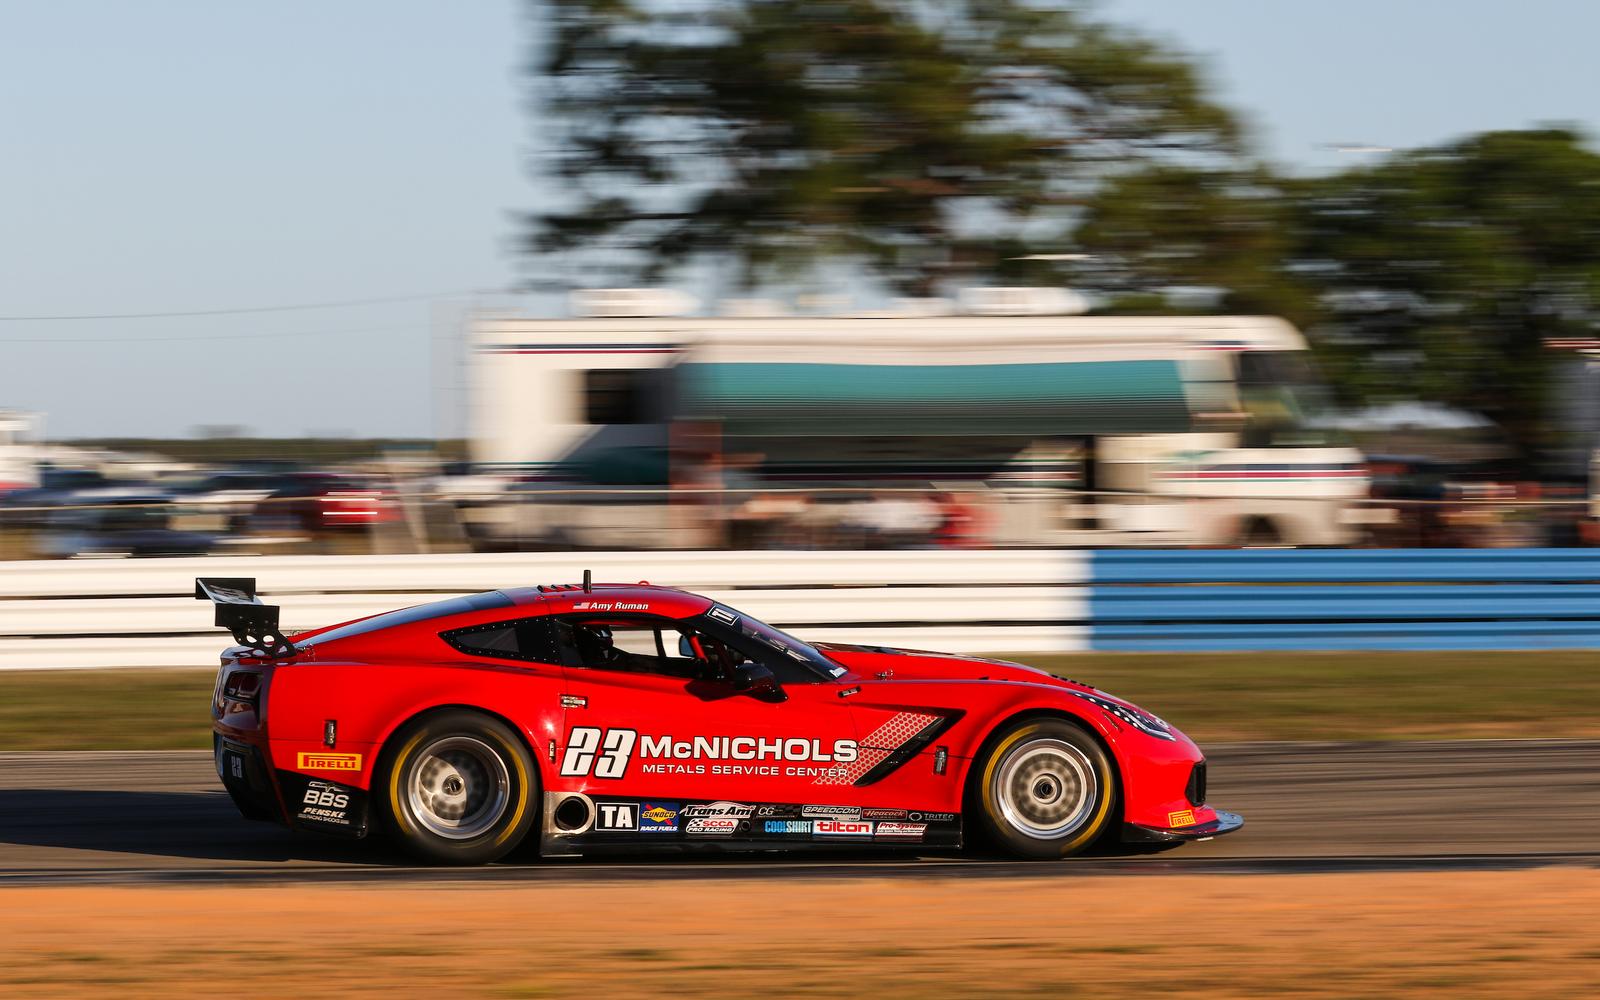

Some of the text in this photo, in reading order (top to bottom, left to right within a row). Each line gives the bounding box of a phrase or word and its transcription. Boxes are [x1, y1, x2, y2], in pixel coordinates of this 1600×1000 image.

[590, 602, 649, 611] Amy Ruman
[560, 727, 637, 779] 23
[640, 735, 858, 762] McNICHOLS
[303, 754, 357, 769] PIRELLI
[642, 764, 848, 777] METALS SERVICE CENTER
[303, 789, 350, 808] BBS
[303, 807, 347, 818] PENSKE
[686, 805, 752, 815] Trans Am
[758, 806, 775, 816] CG
[804, 806, 860, 814] SPEEDCOM
[601, 806, 633, 828] TA
[817, 821, 870, 833] tilton
